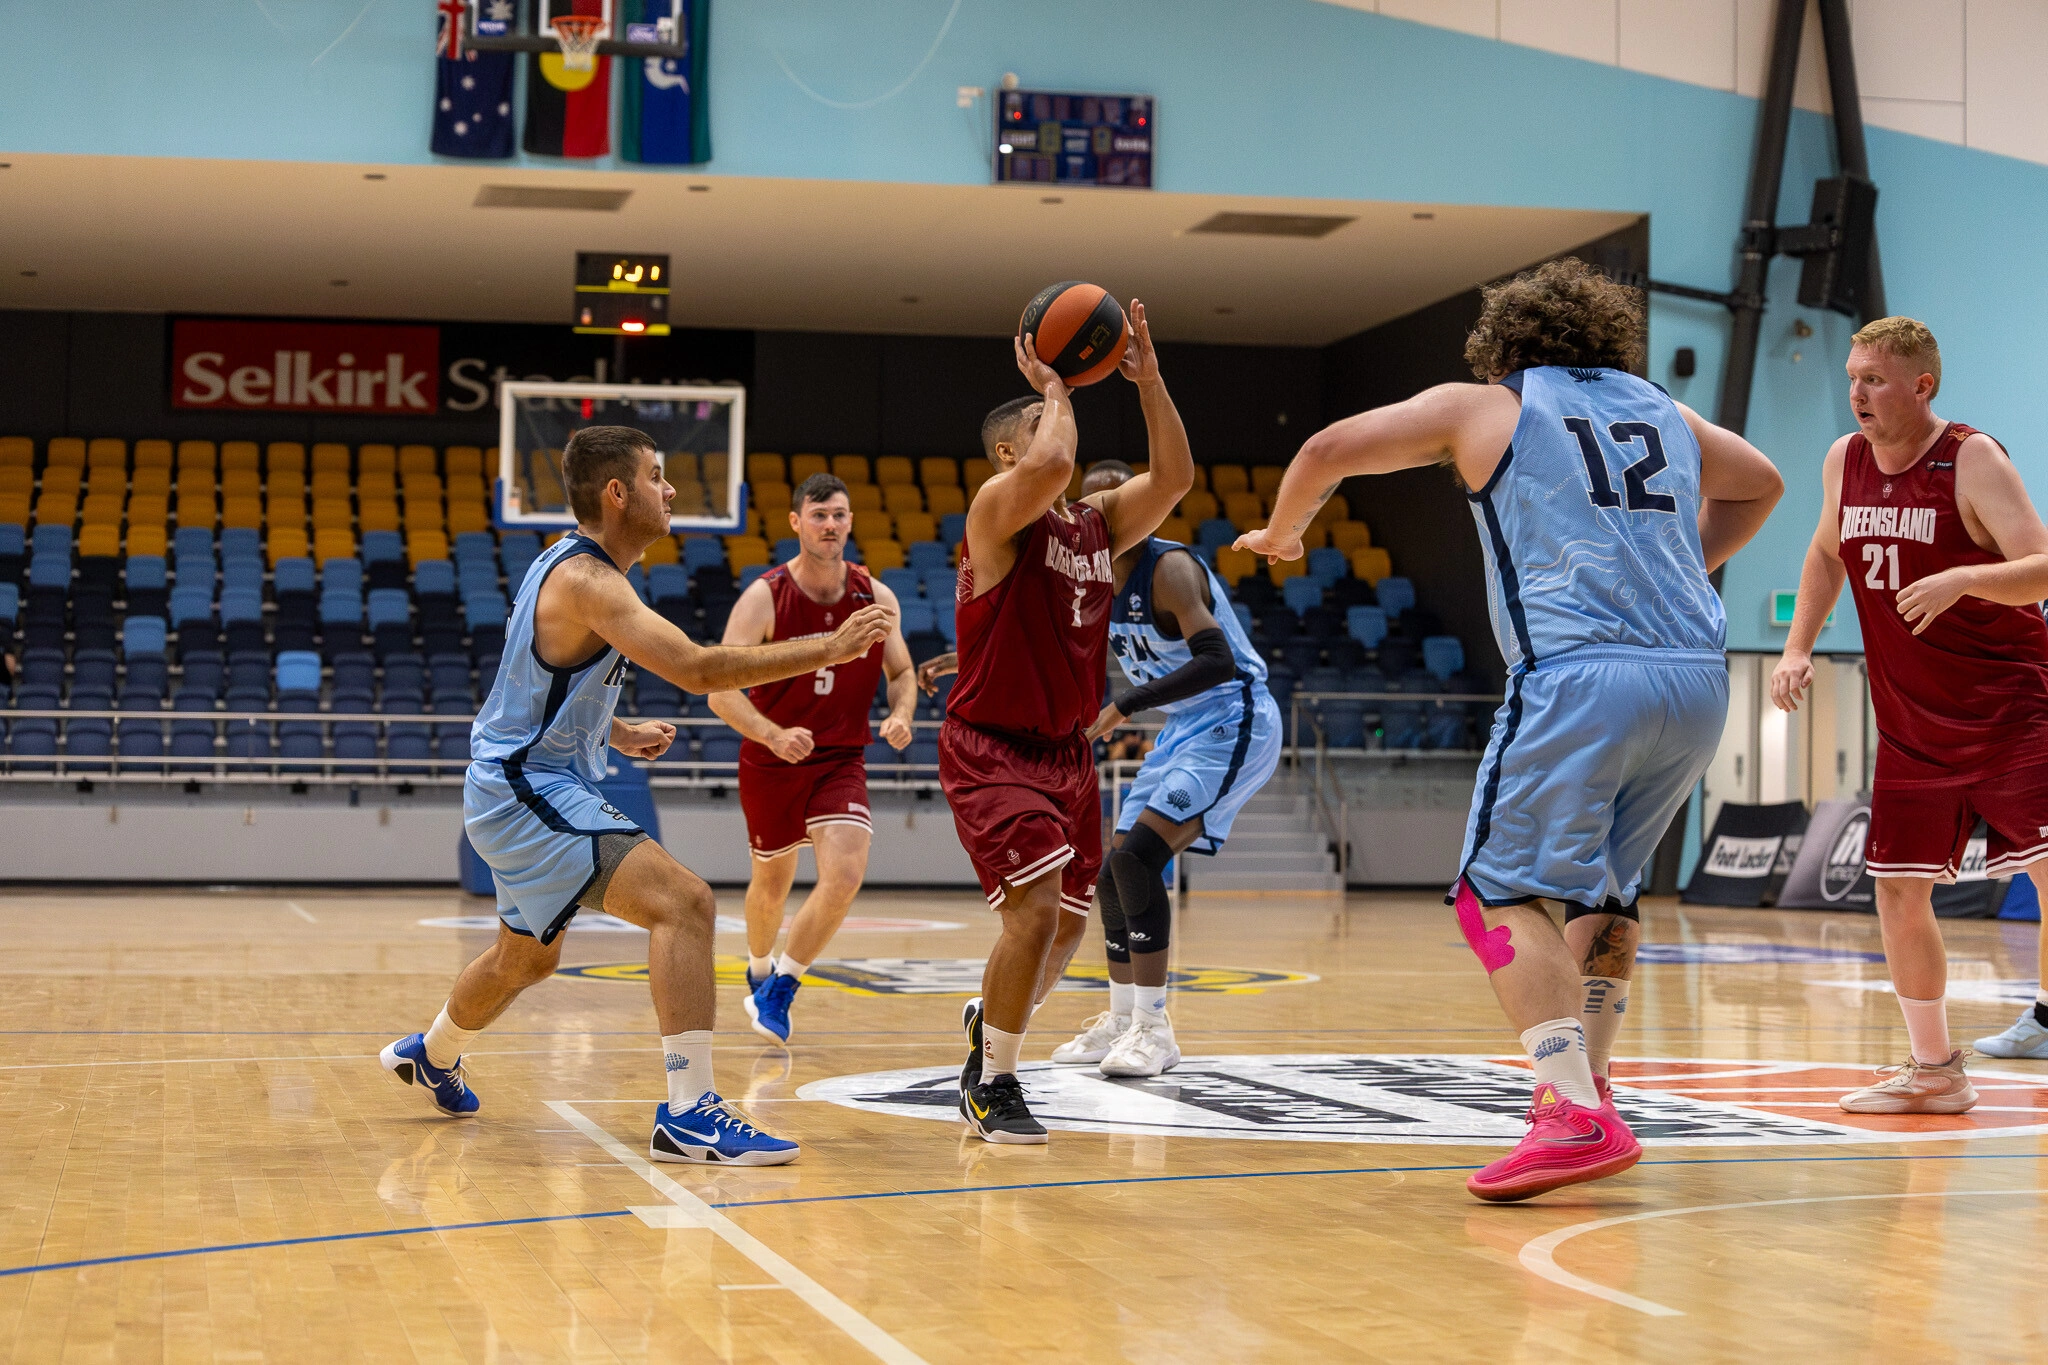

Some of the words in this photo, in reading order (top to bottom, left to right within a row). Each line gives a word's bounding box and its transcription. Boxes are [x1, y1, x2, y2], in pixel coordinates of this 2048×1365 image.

[183, 350, 429, 408] Selkirk
[446, 357, 746, 412] Stadum
[1562, 415, 1677, 515] 12
[1840, 505, 1937, 545] QUEENSLAND
[1862, 543, 1900, 591] 21
[813, 663, 836, 696] 5
